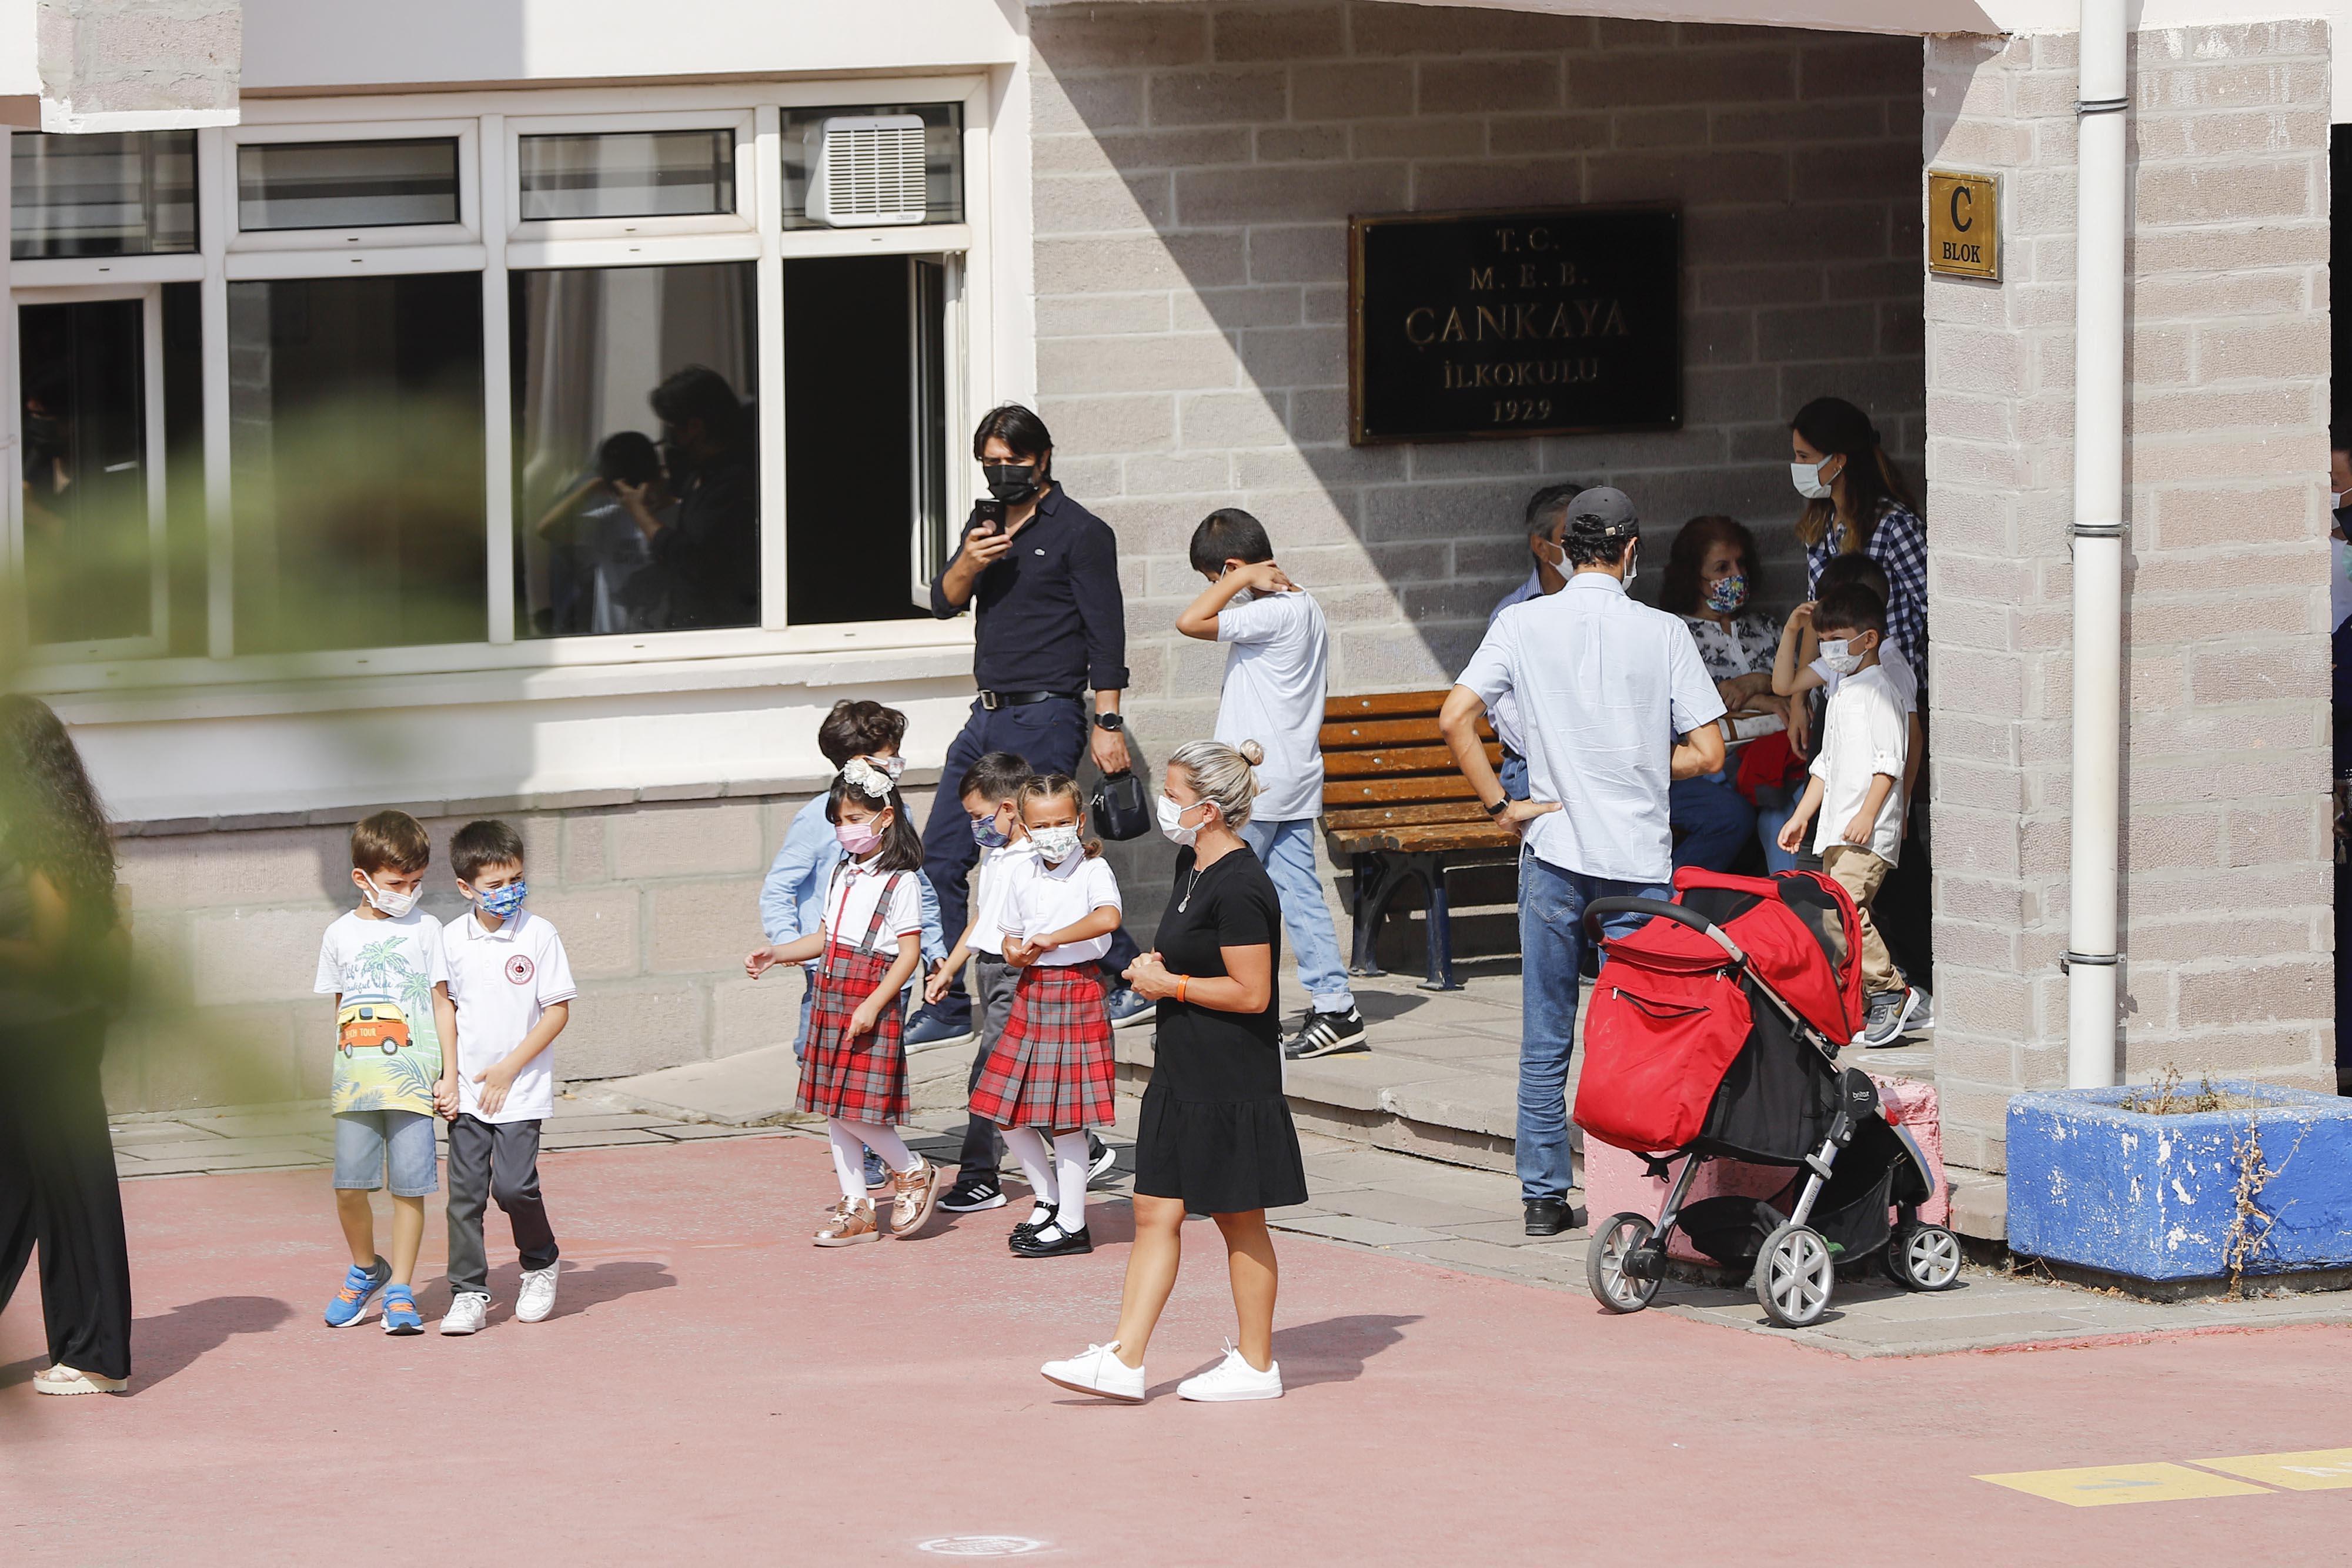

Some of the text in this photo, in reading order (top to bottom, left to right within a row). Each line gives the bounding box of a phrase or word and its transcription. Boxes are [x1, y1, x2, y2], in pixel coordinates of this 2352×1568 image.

[1951, 186, 1972, 232] C
[1943, 242, 1980, 263] BLOK
[1405, 299, 1629, 352] ÇANKAYA
[1444, 358, 1601, 389] İLKOKULU
[1492, 399, 1553, 422] 1929
[359, 1027, 376, 1037] TOUR
